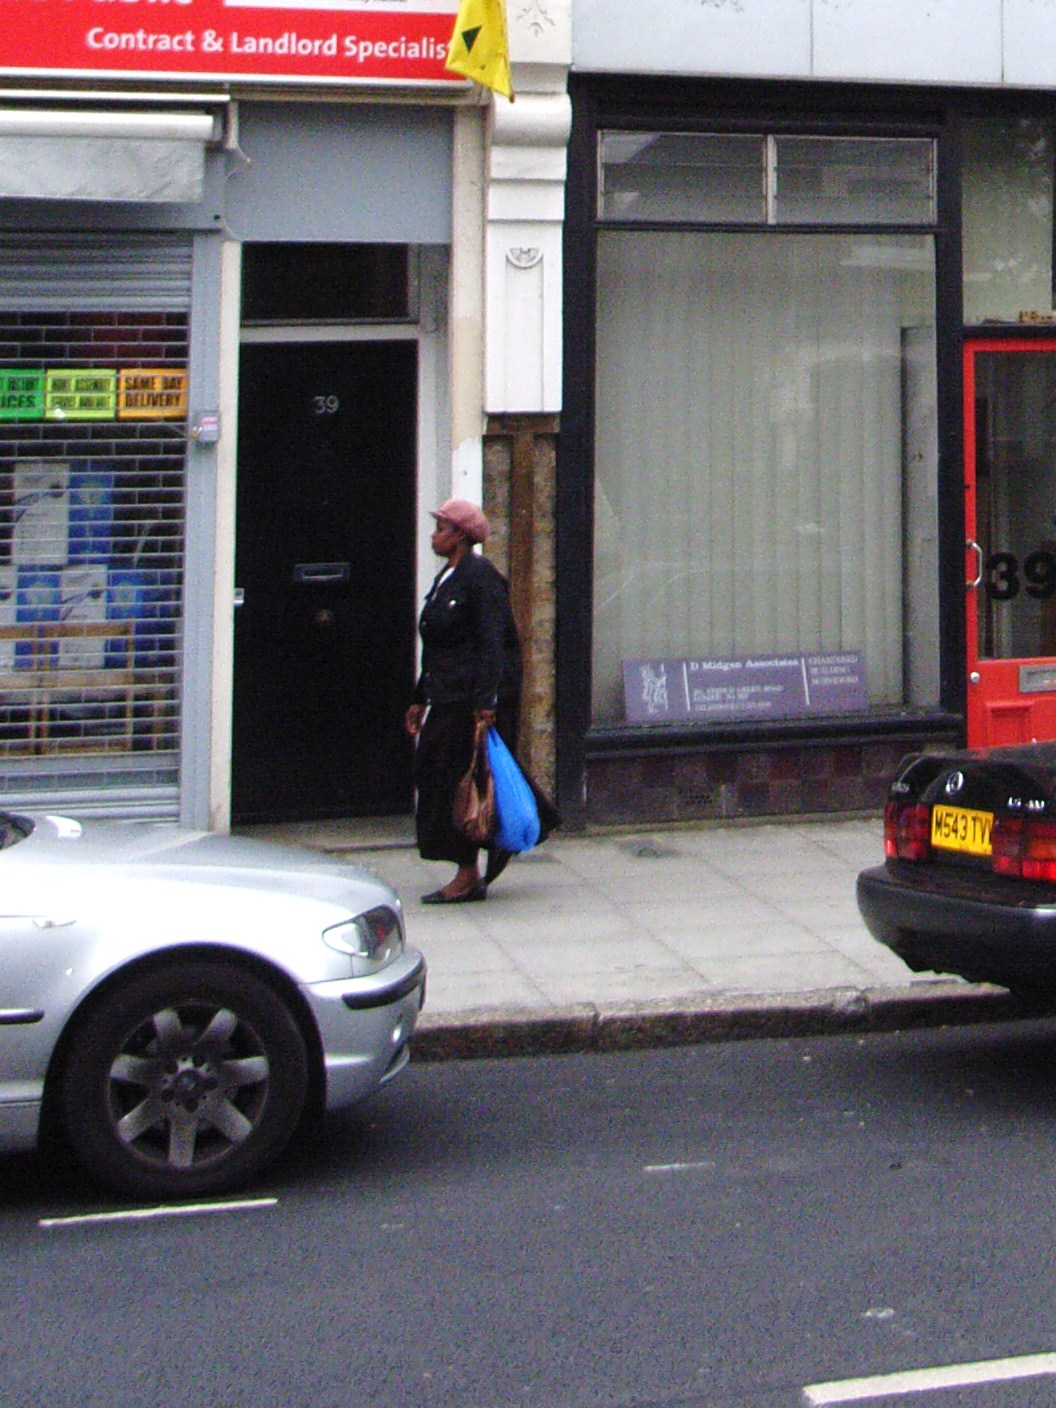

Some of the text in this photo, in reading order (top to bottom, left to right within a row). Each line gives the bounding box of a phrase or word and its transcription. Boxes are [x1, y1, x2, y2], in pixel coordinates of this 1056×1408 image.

[87, 27, 451, 63] Contract & Landlord Specialis
[125, 376, 155, 391] SAME
[125, 393, 181, 407] DELIVERY
[313, 395, 340, 414] 39
[934, 810, 968, 841] M543
